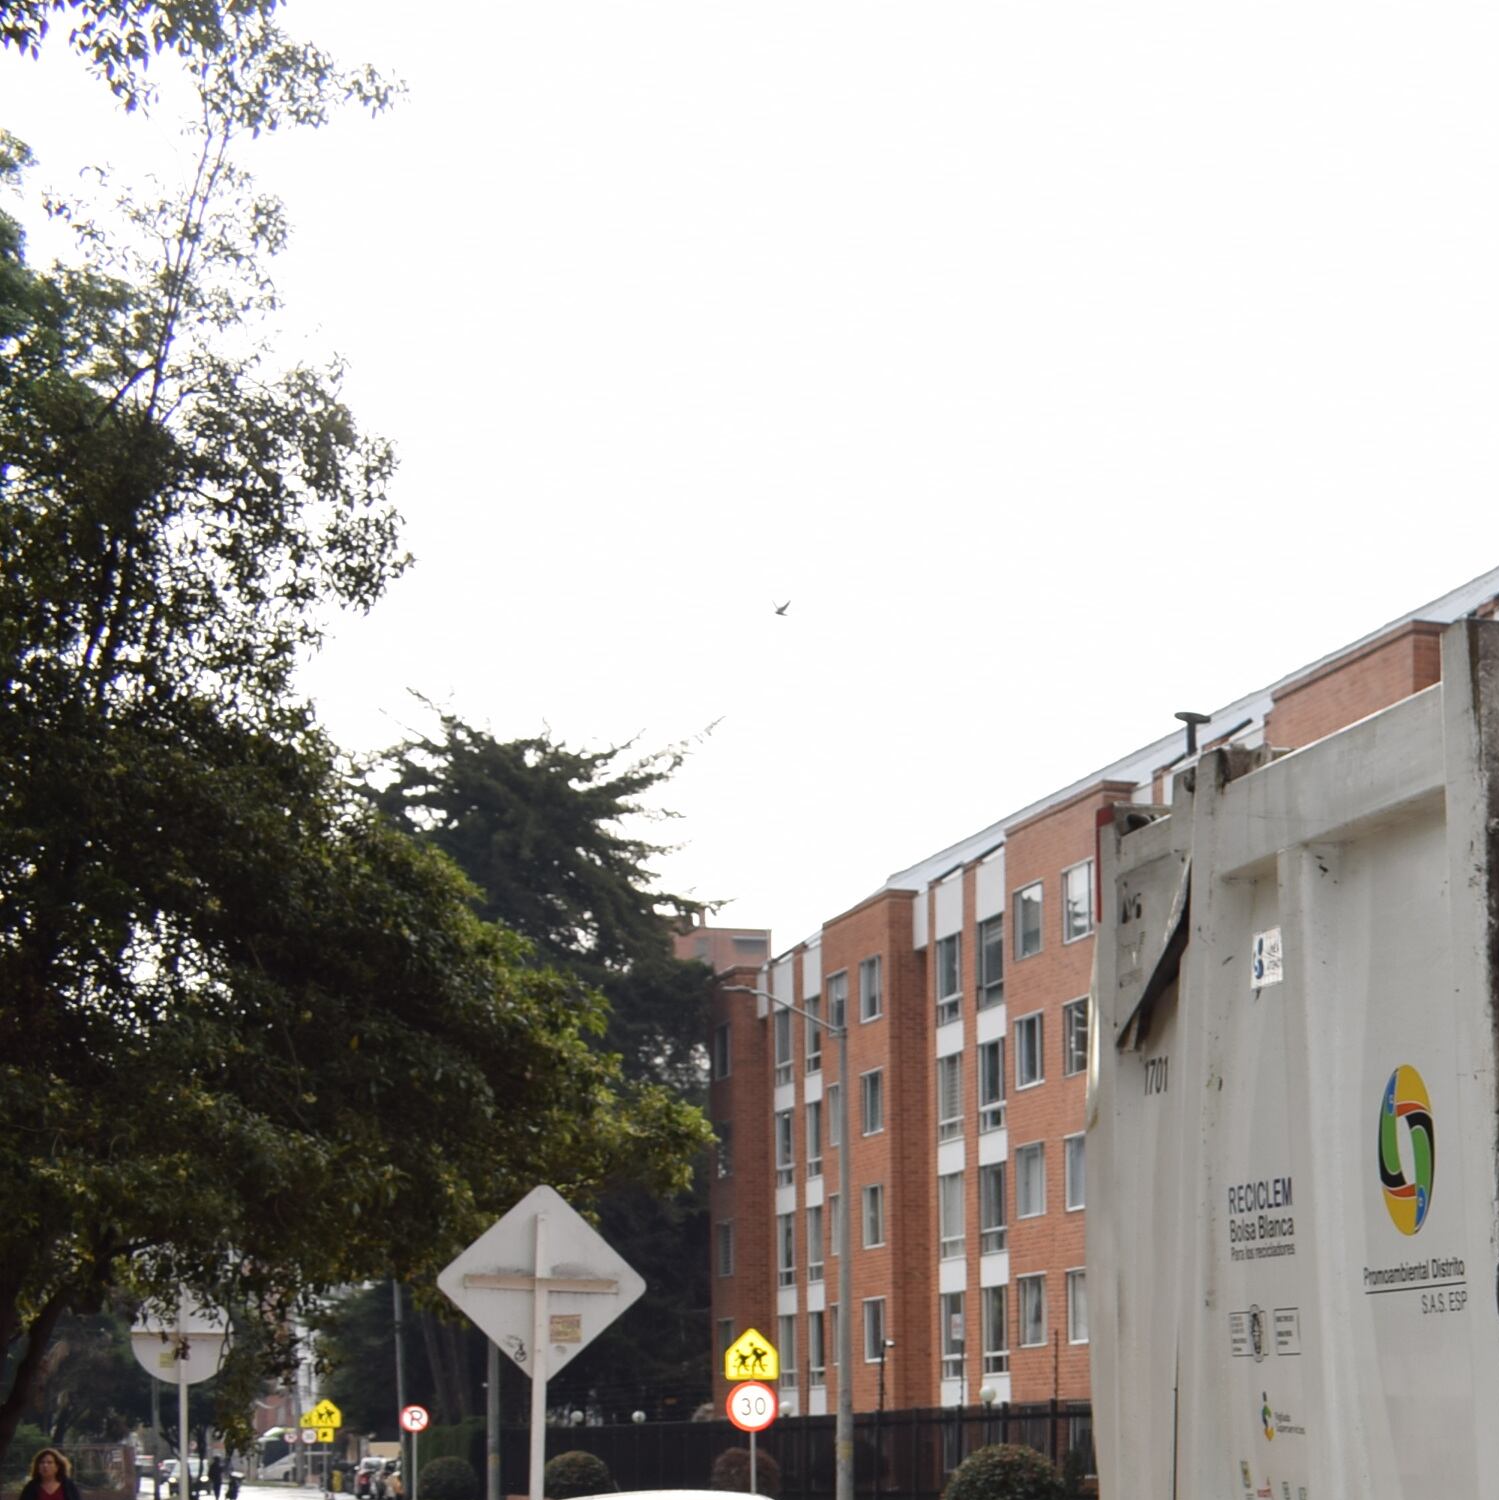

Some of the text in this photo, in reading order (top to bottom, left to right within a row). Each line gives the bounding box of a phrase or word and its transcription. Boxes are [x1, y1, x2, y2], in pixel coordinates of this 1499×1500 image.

[1144, 1055, 1169, 1096] 1701
[1230, 1214, 1294, 1243] Bolsa Blanca
[1363, 1257, 1465, 1286] Promoambiental Distrito
[1422, 1290, 1467, 1314] S.A.S. ESP
[741, 1397, 766, 1416] 30
